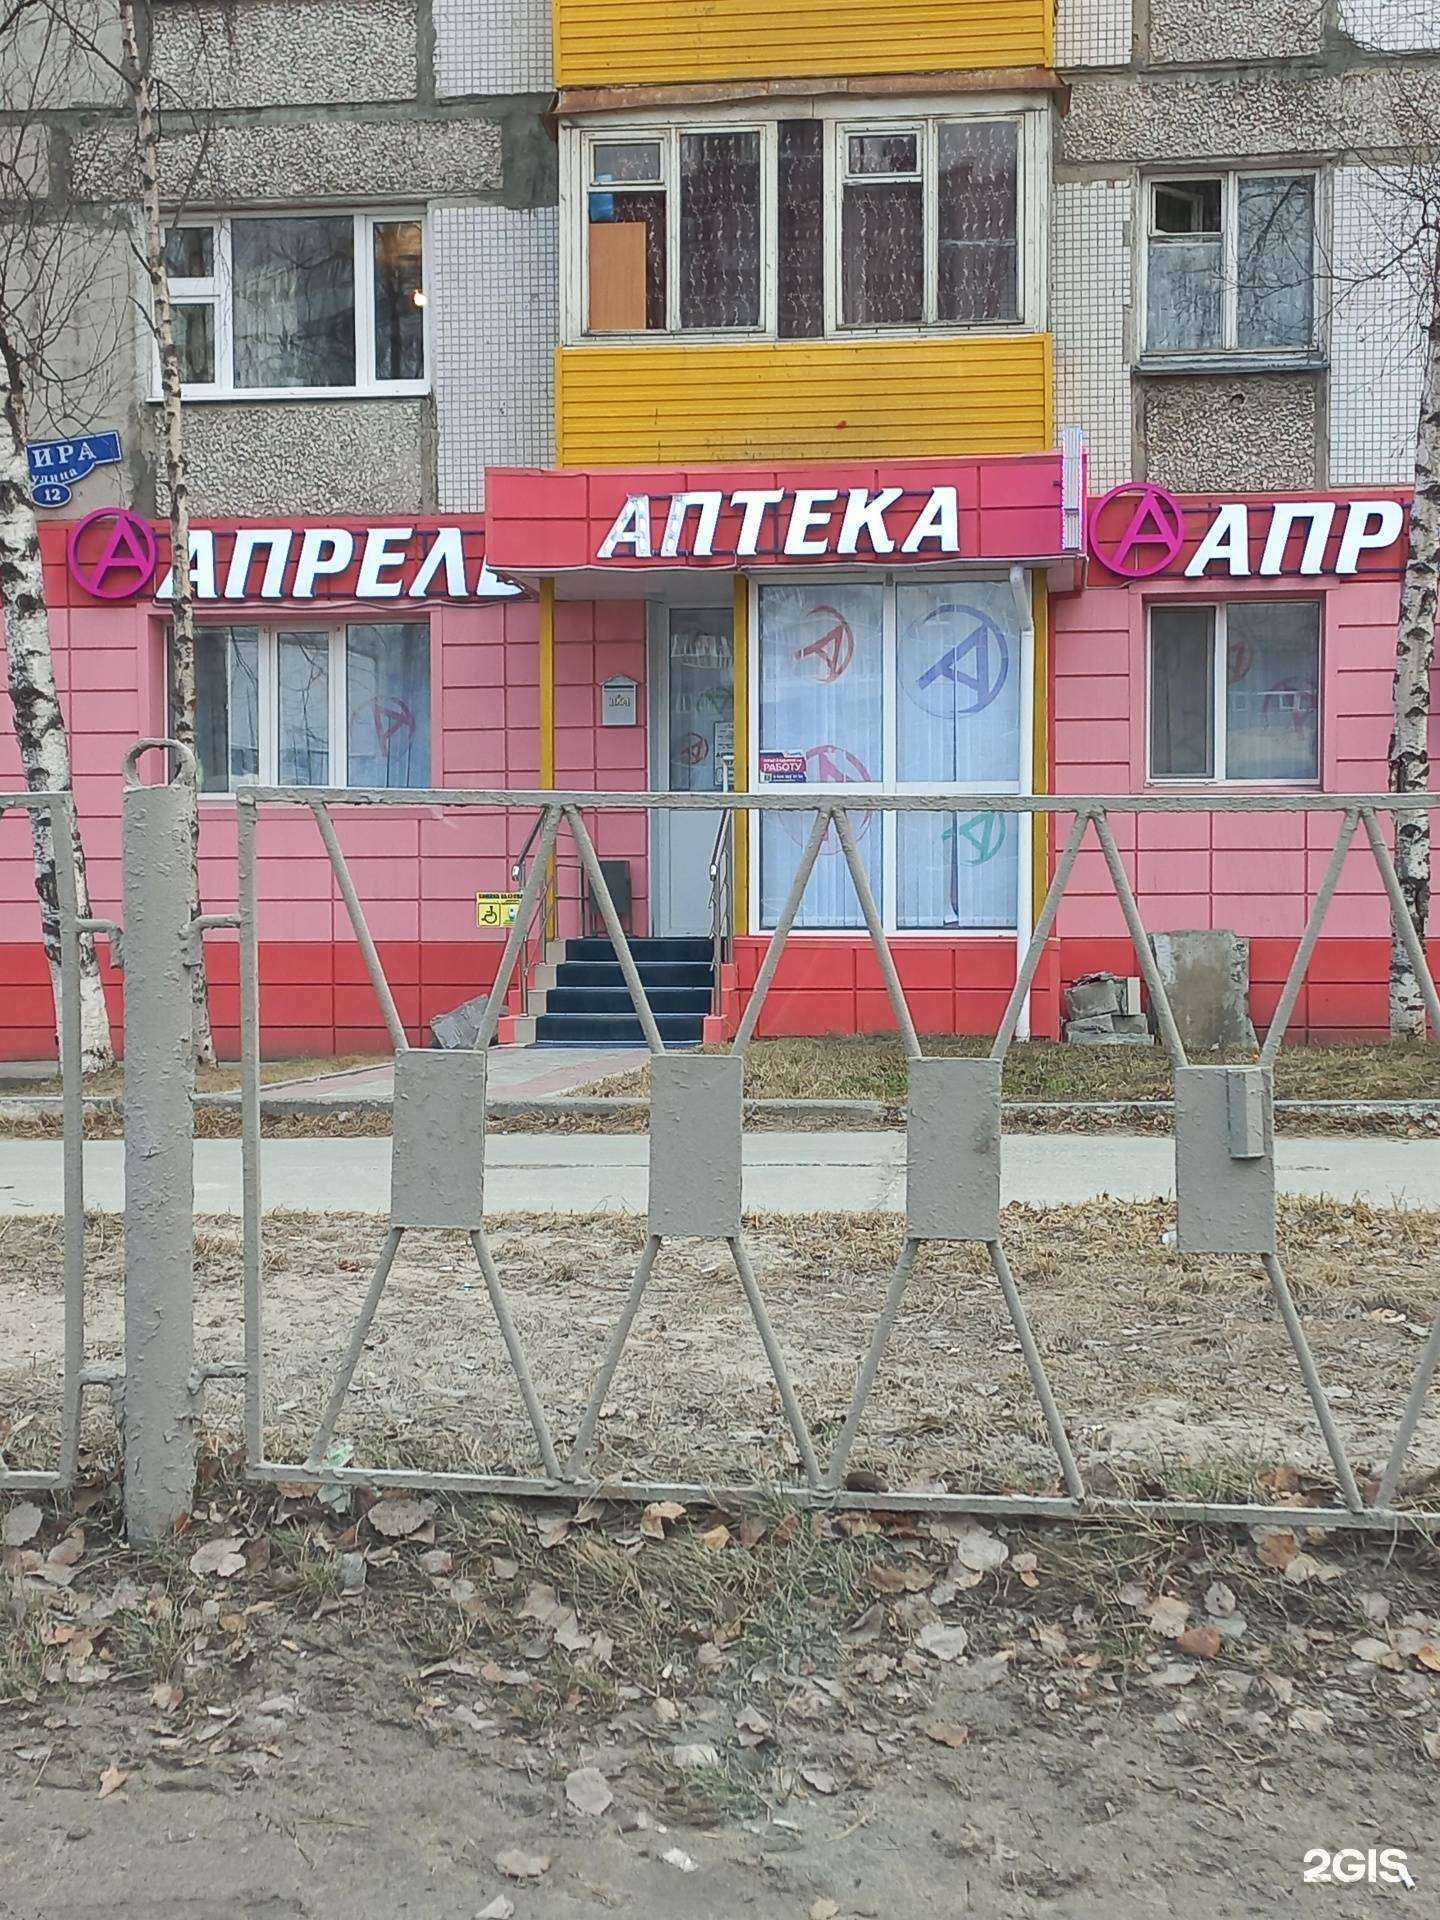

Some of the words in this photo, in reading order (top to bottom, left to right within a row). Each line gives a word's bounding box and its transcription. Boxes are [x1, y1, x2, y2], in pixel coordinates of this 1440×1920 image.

[31, 441, 97, 468] ИРА
[31, 468, 78, 486] улица
[44, 488, 61, 501] 12
[596, 486, 960, 558] АПТЕКА
[1183, 500, 1404, 577] АПР
[763, 762, 802, 772] РАБОТУ
